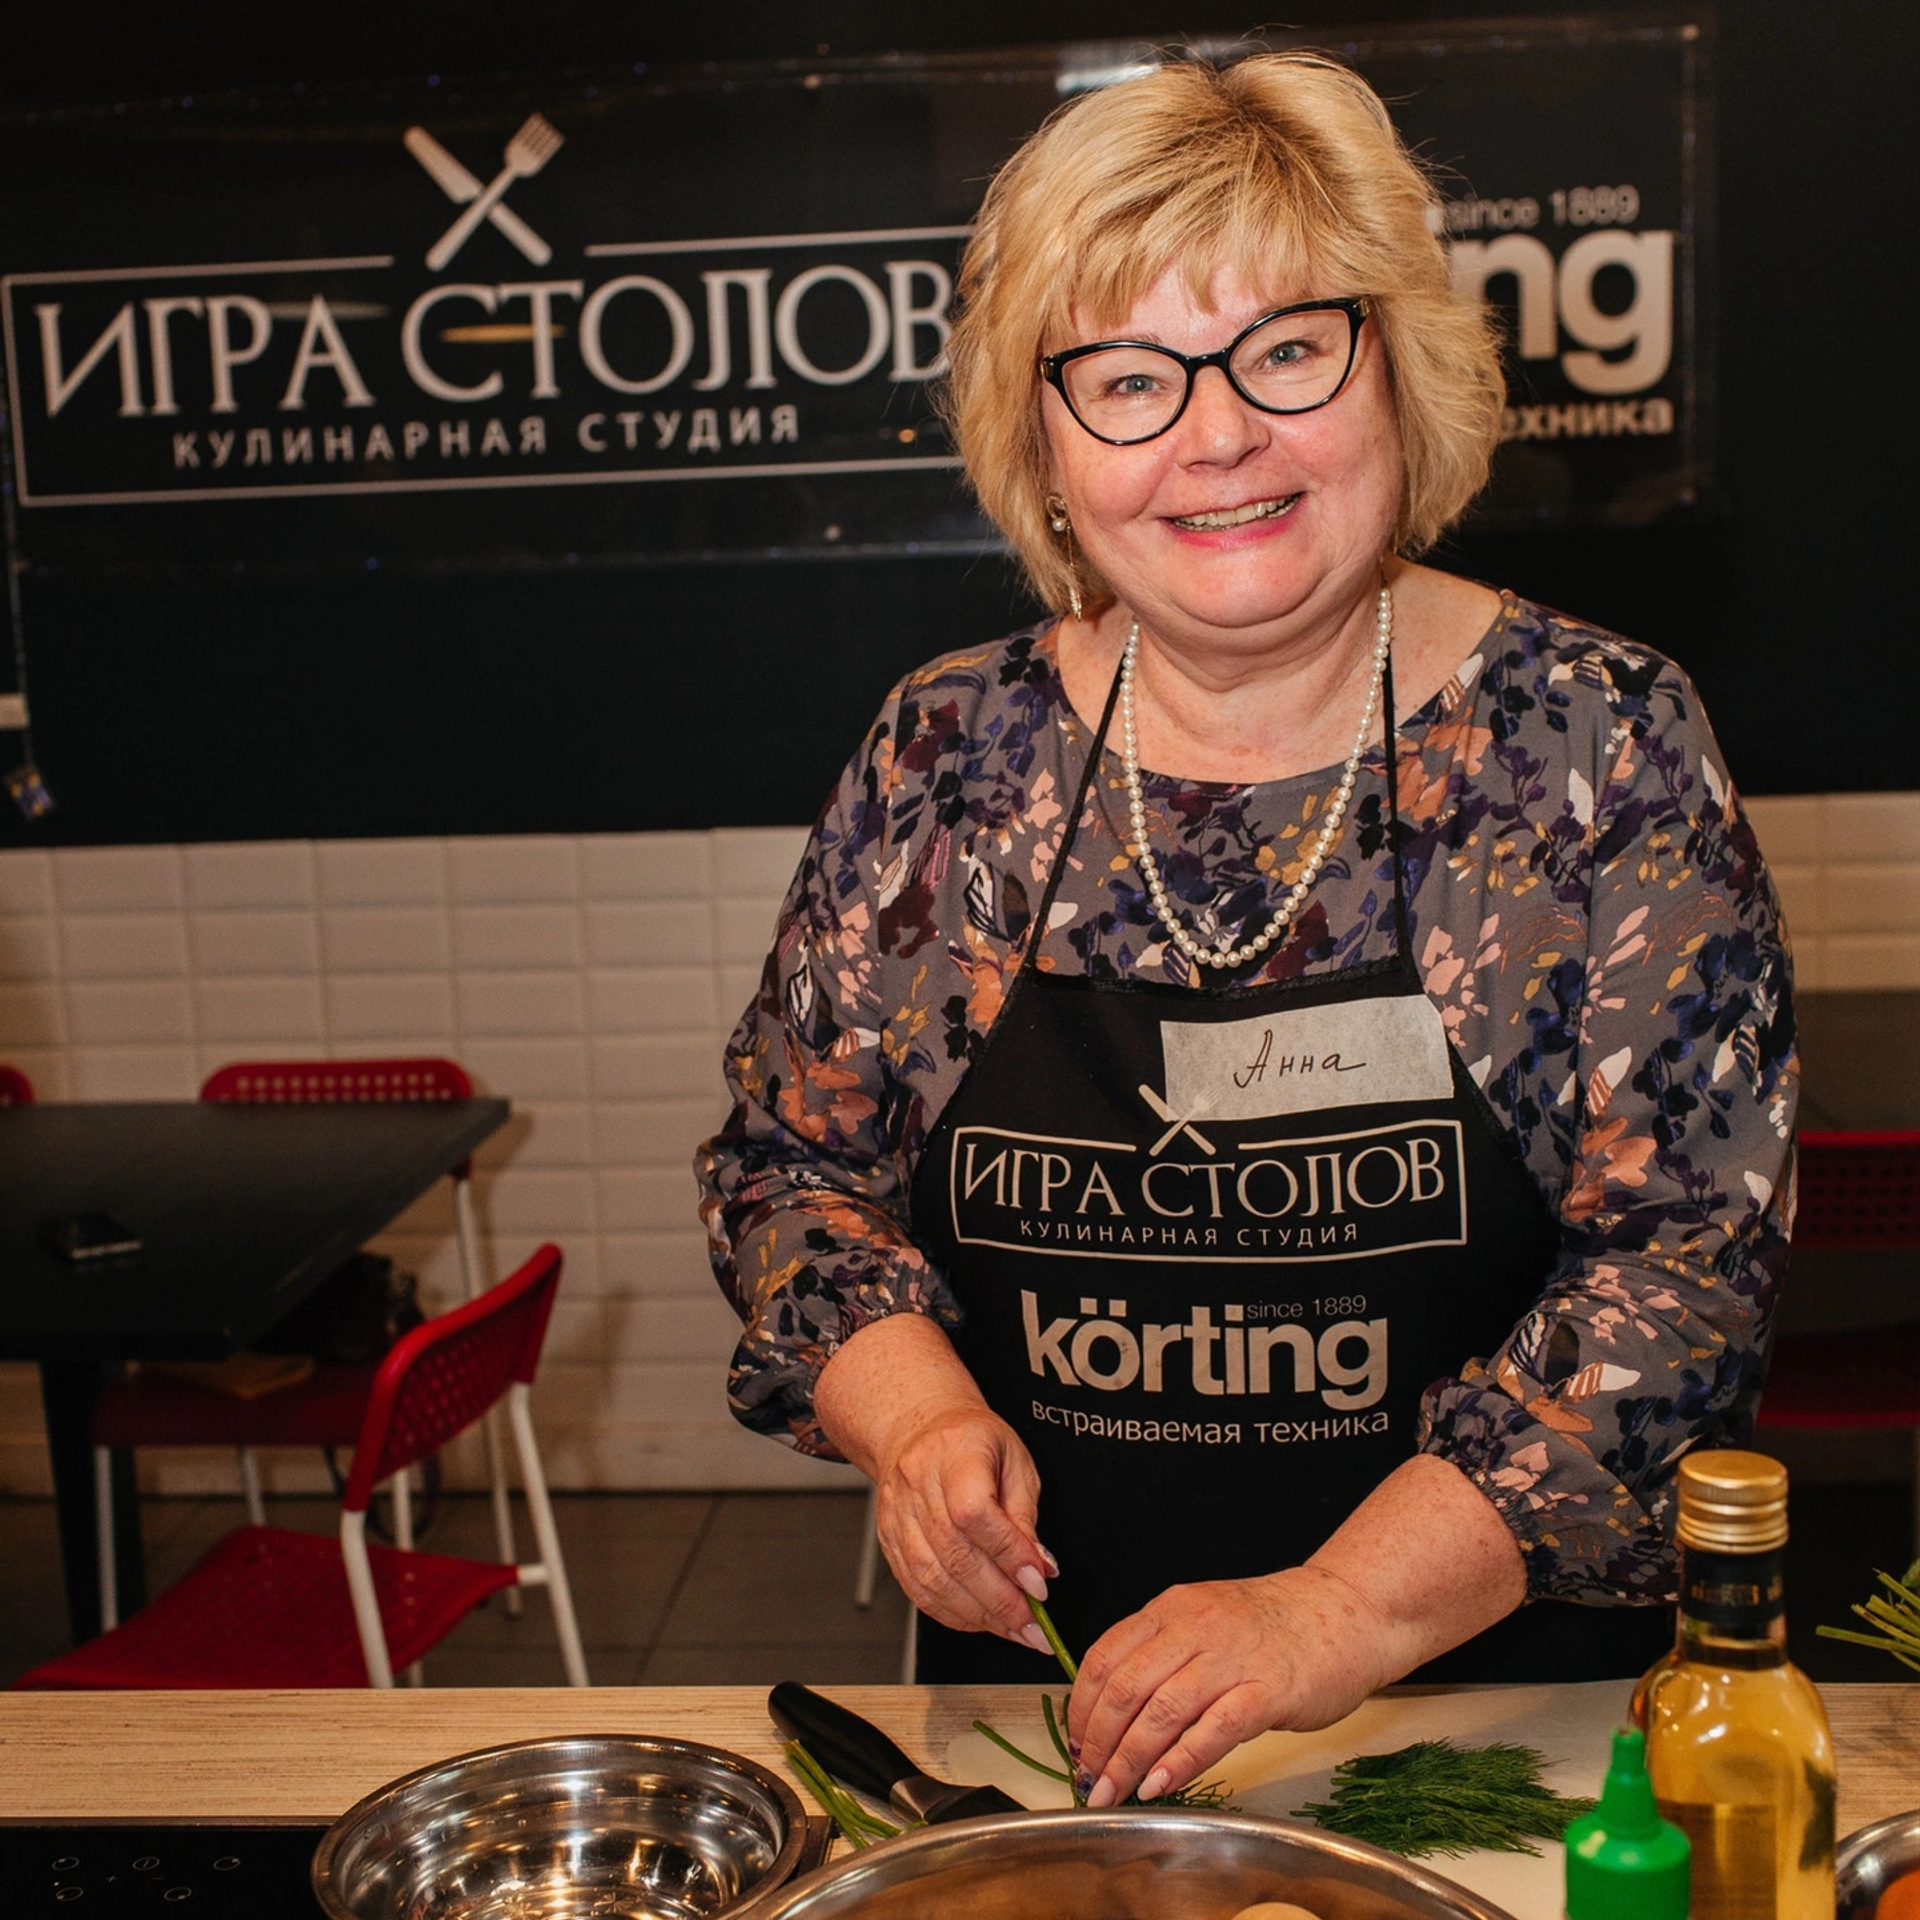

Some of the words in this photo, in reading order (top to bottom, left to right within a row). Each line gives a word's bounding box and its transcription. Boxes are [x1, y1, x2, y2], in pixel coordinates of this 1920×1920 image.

[1446, 197, 1540, 231] since
[1551, 184, 1640, 227] 1889
[36, 294, 376, 417] ИГРА
[402, 260, 955, 402] СТОЛОВ
[173, 416, 546, 468] КУЛИНАРНАЯ
[577, 404, 799, 454] СТУДИЯ
[1500, 398, 1673, 440] ехника
[1233, 1029, 1367, 1089] Анна
[964, 1143, 1125, 1216] ИГРА
[1141, 1138, 1445, 1218] СТОЛОВ
[1020, 1219, 1218, 1246] КУЛИНАРНАЯ
[1236, 1223, 1358, 1249] СТУДИЯ
[1246, 1299, 1304, 1320] since
[1312, 1294, 1367, 1316] 1889
[1020, 1289, 1388, 1411] körting
[1032, 1400, 1241, 1444] встраиваемая
[1254, 1411, 1389, 1444] техника
